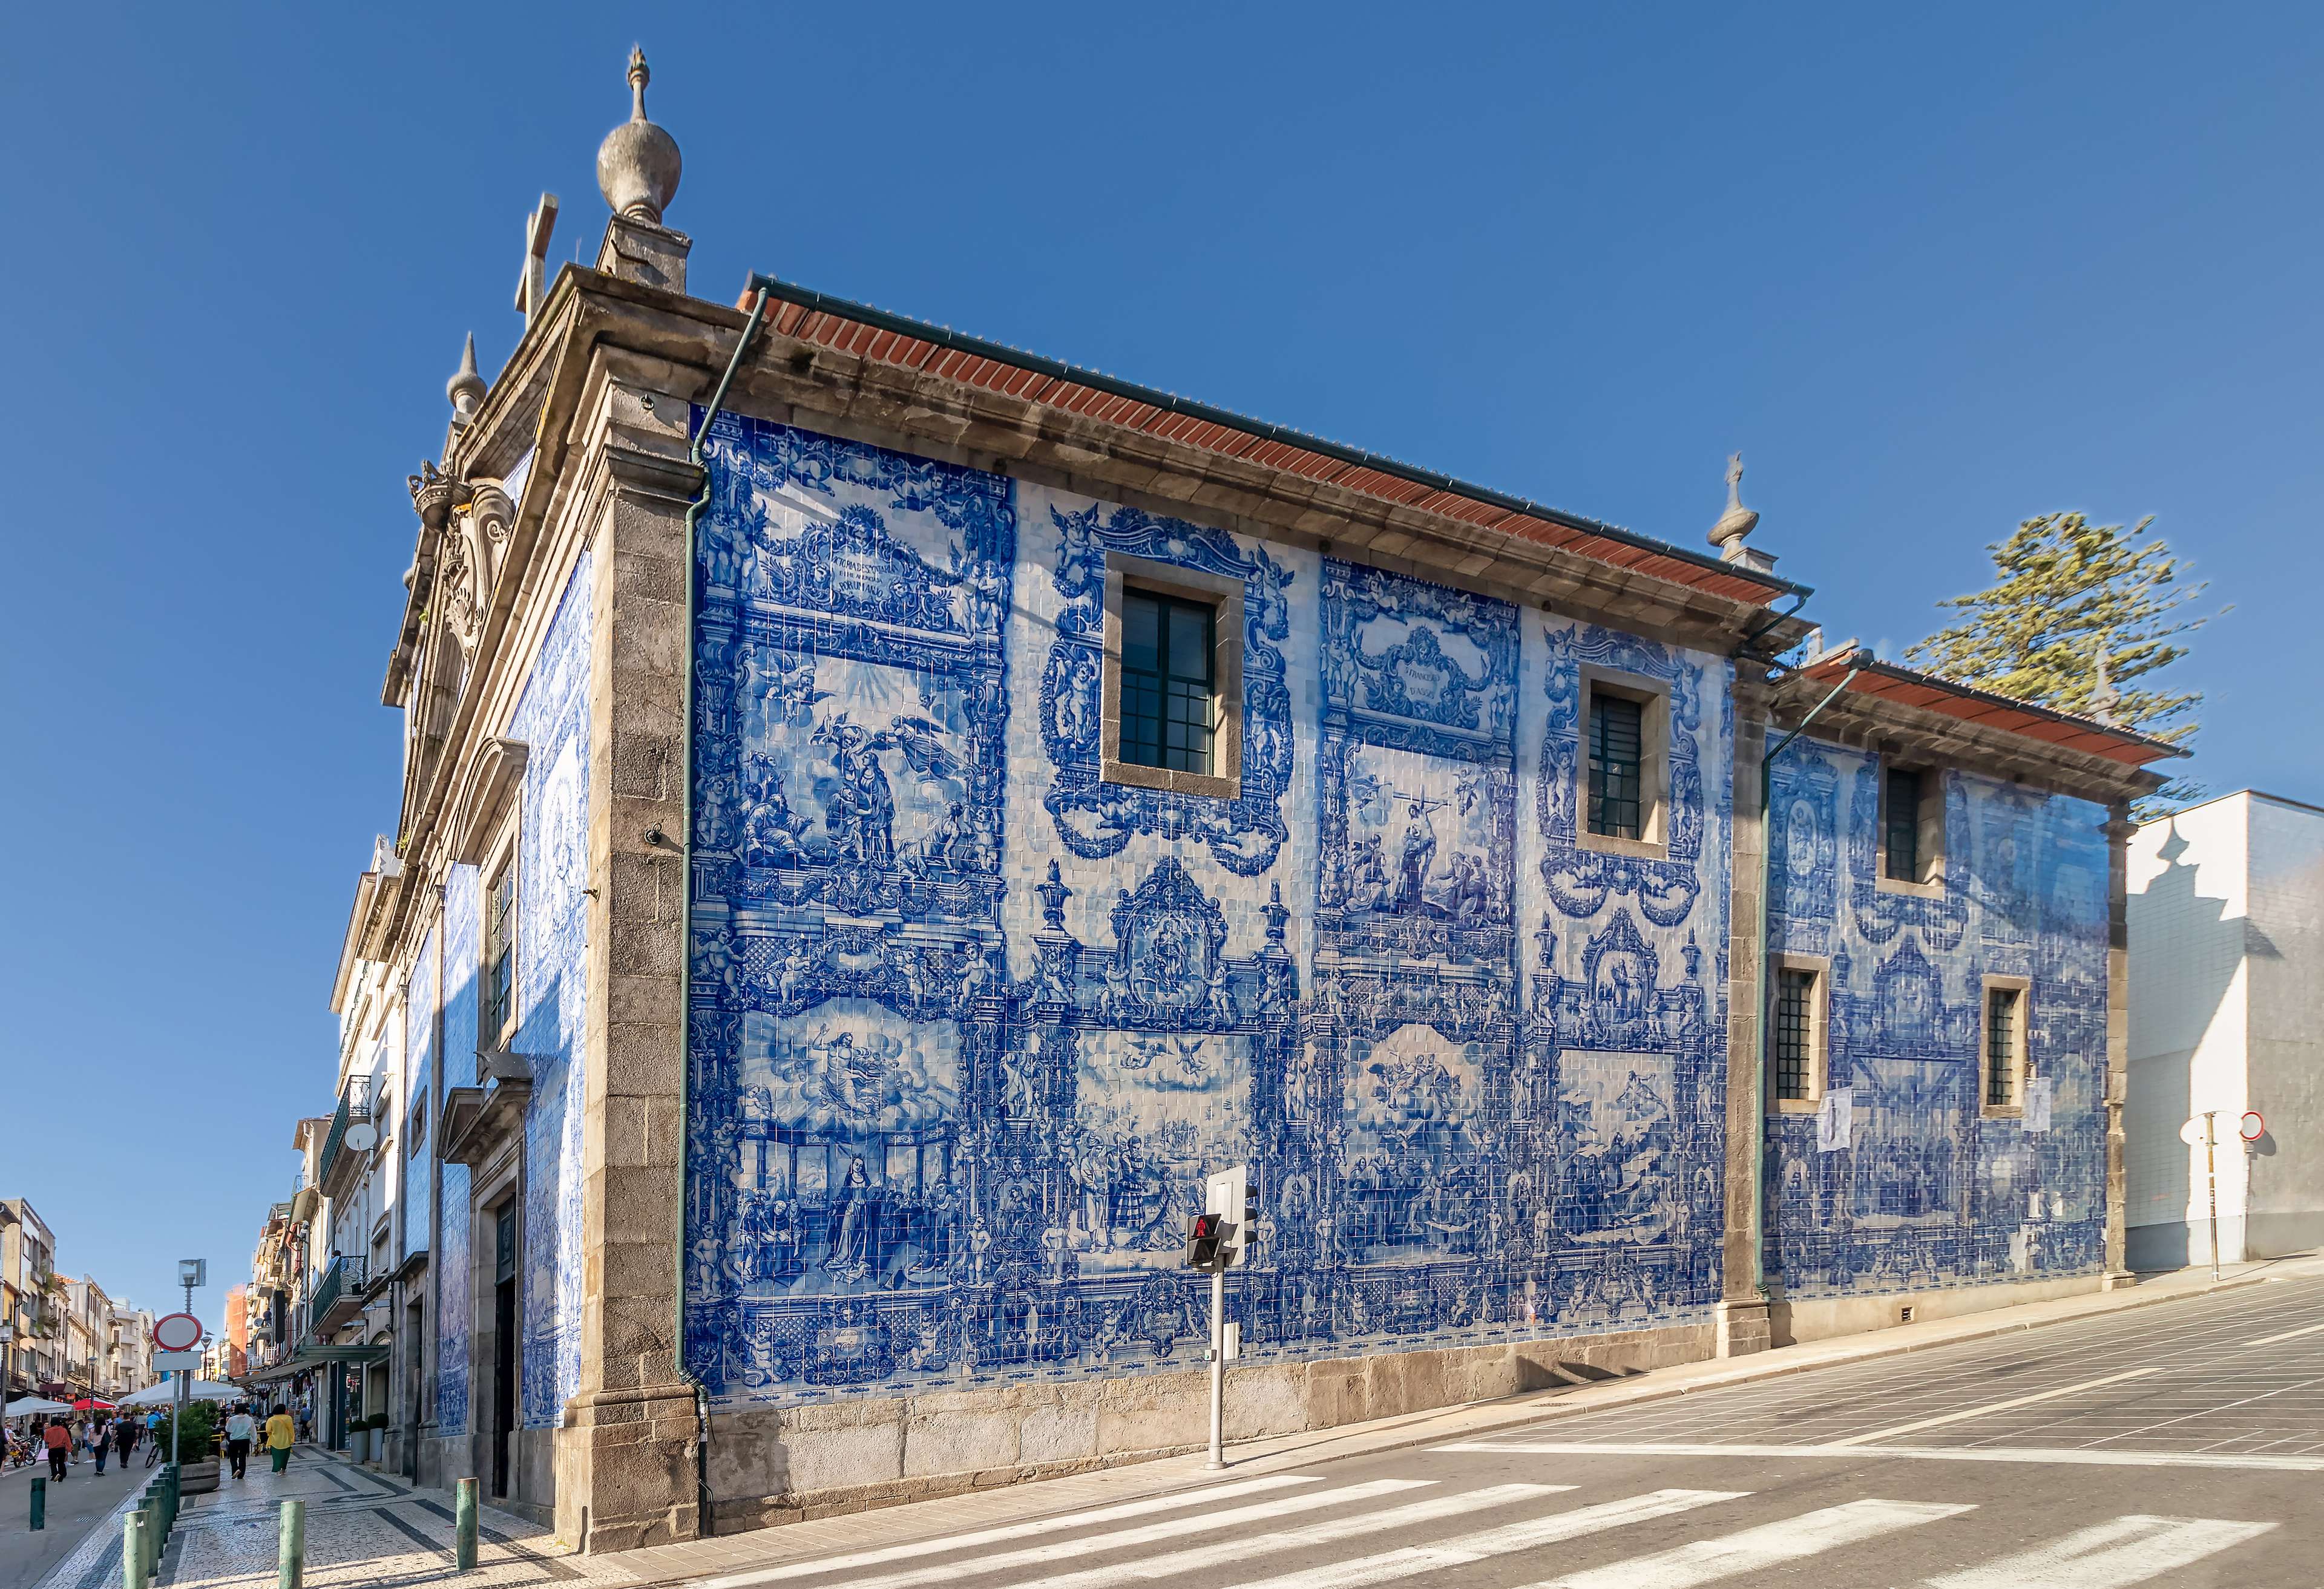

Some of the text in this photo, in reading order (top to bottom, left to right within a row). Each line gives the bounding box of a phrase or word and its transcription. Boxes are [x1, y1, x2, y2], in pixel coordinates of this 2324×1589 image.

[839, 581, 883, 597] POR UM ANJO
